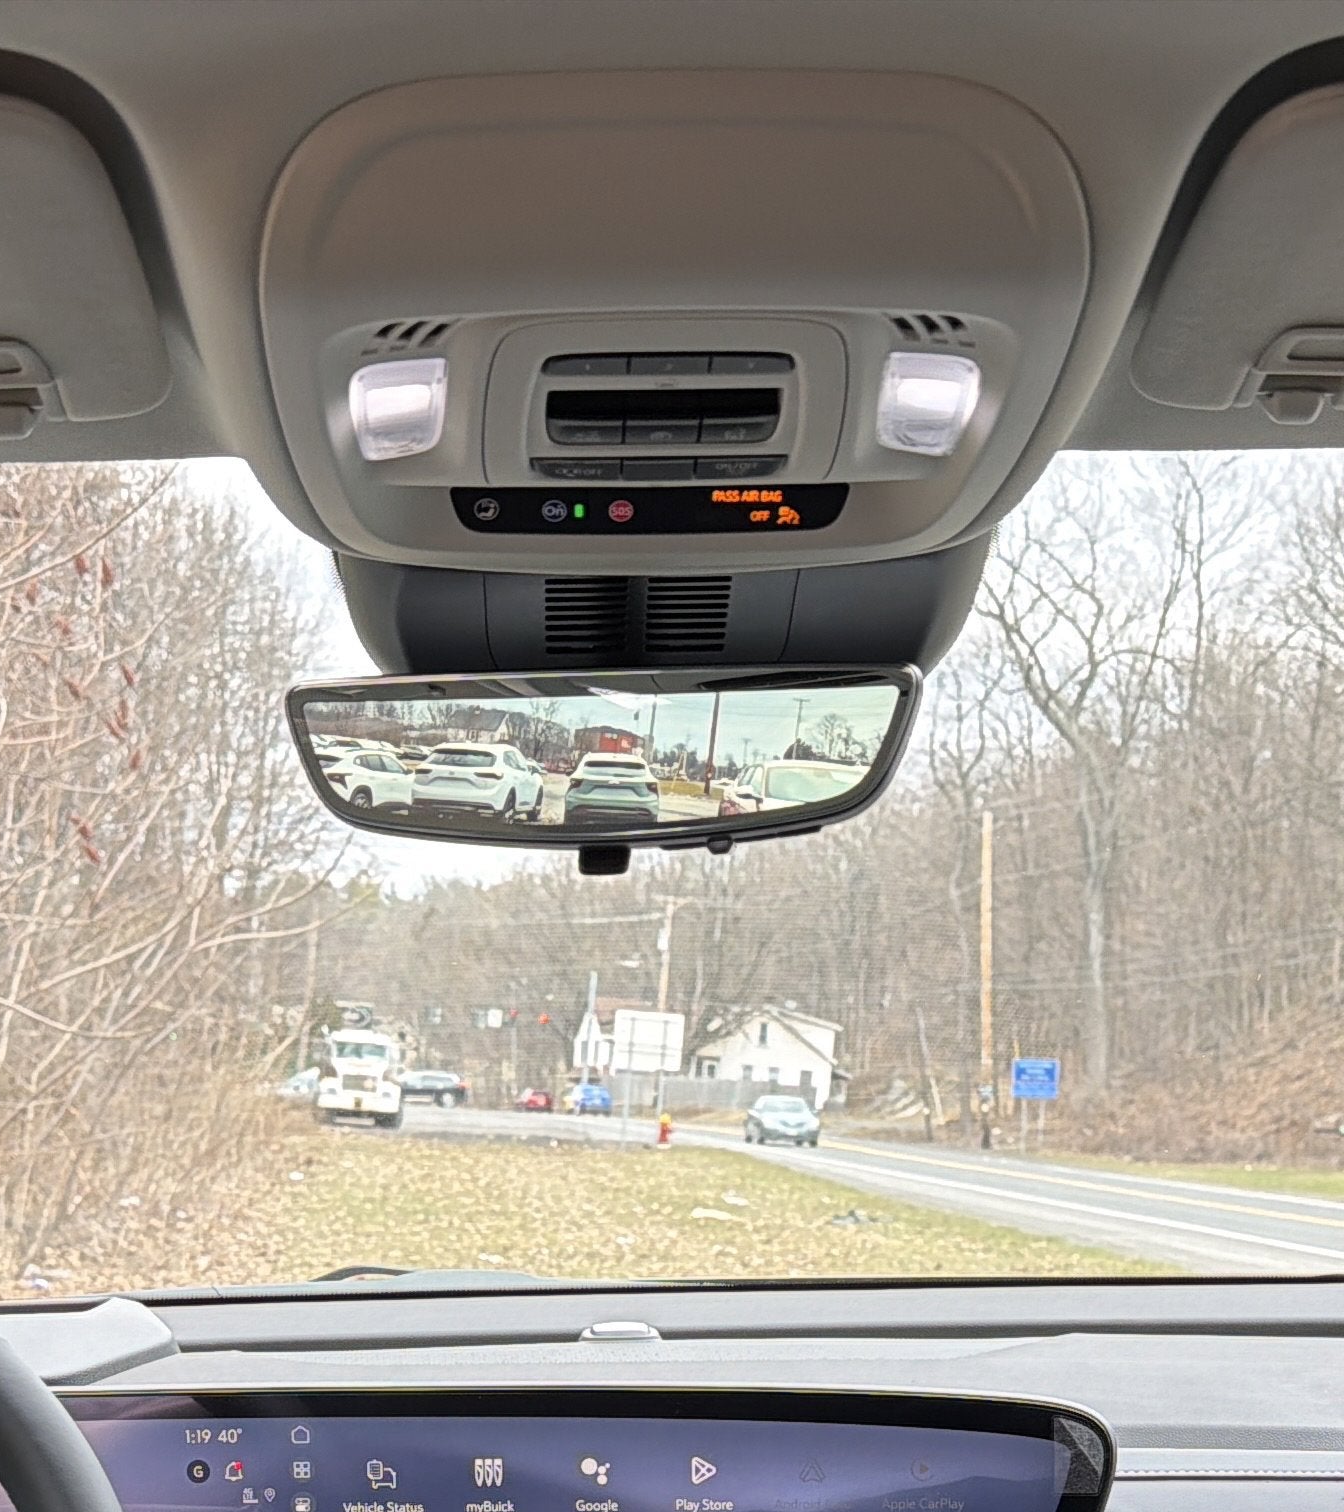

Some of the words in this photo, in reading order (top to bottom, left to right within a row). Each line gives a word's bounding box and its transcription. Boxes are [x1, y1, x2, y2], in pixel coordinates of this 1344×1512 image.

[712, 489, 739, 503] PASS
[741, 489, 759, 503] AIR
[760, 489, 783, 504] BAG
[610, 504, 632, 517] SOS
[750, 510, 770, 522] OFF
[185, 1428, 211, 1444] 1:19
[217, 1428, 243, 1444] 40°
[193, 1466, 204, 1478] G
[675, 1499, 700, 1512] Play
[702, 1499, 734, 1511] Store
[882, 1498, 916, 1511] Apple
[918, 1498, 965, 1512] CarPlay
